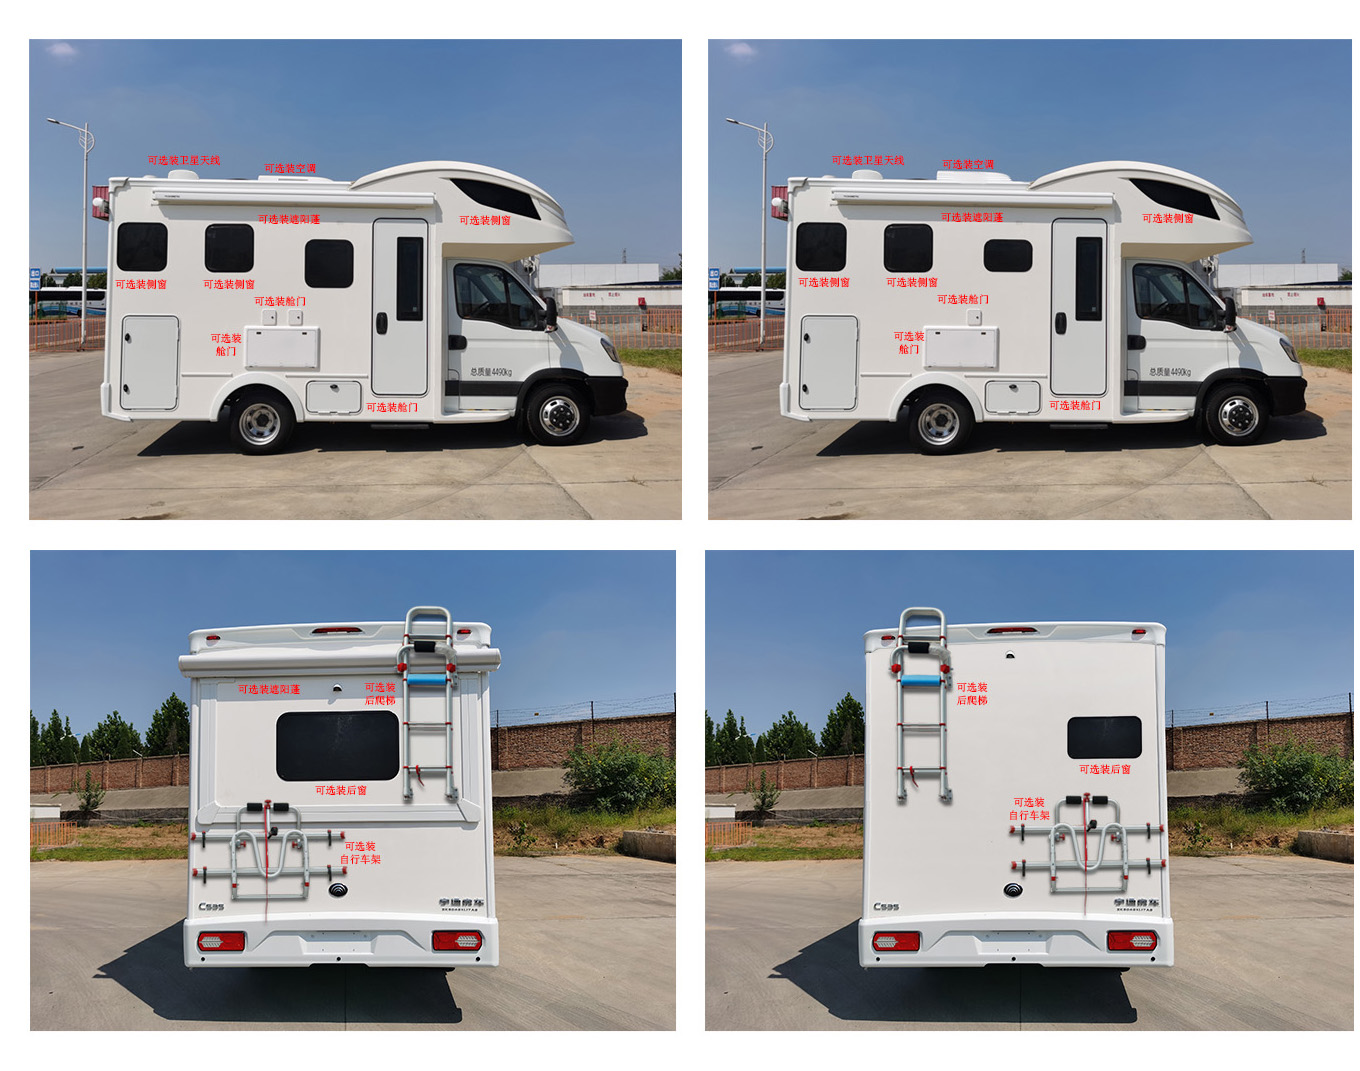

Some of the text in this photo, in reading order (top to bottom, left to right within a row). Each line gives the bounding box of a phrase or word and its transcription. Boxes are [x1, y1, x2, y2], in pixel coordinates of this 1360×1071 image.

[470, 367, 513, 377] 总质量4490kg
[1149, 367, 1192, 377] 总质量4490kg
